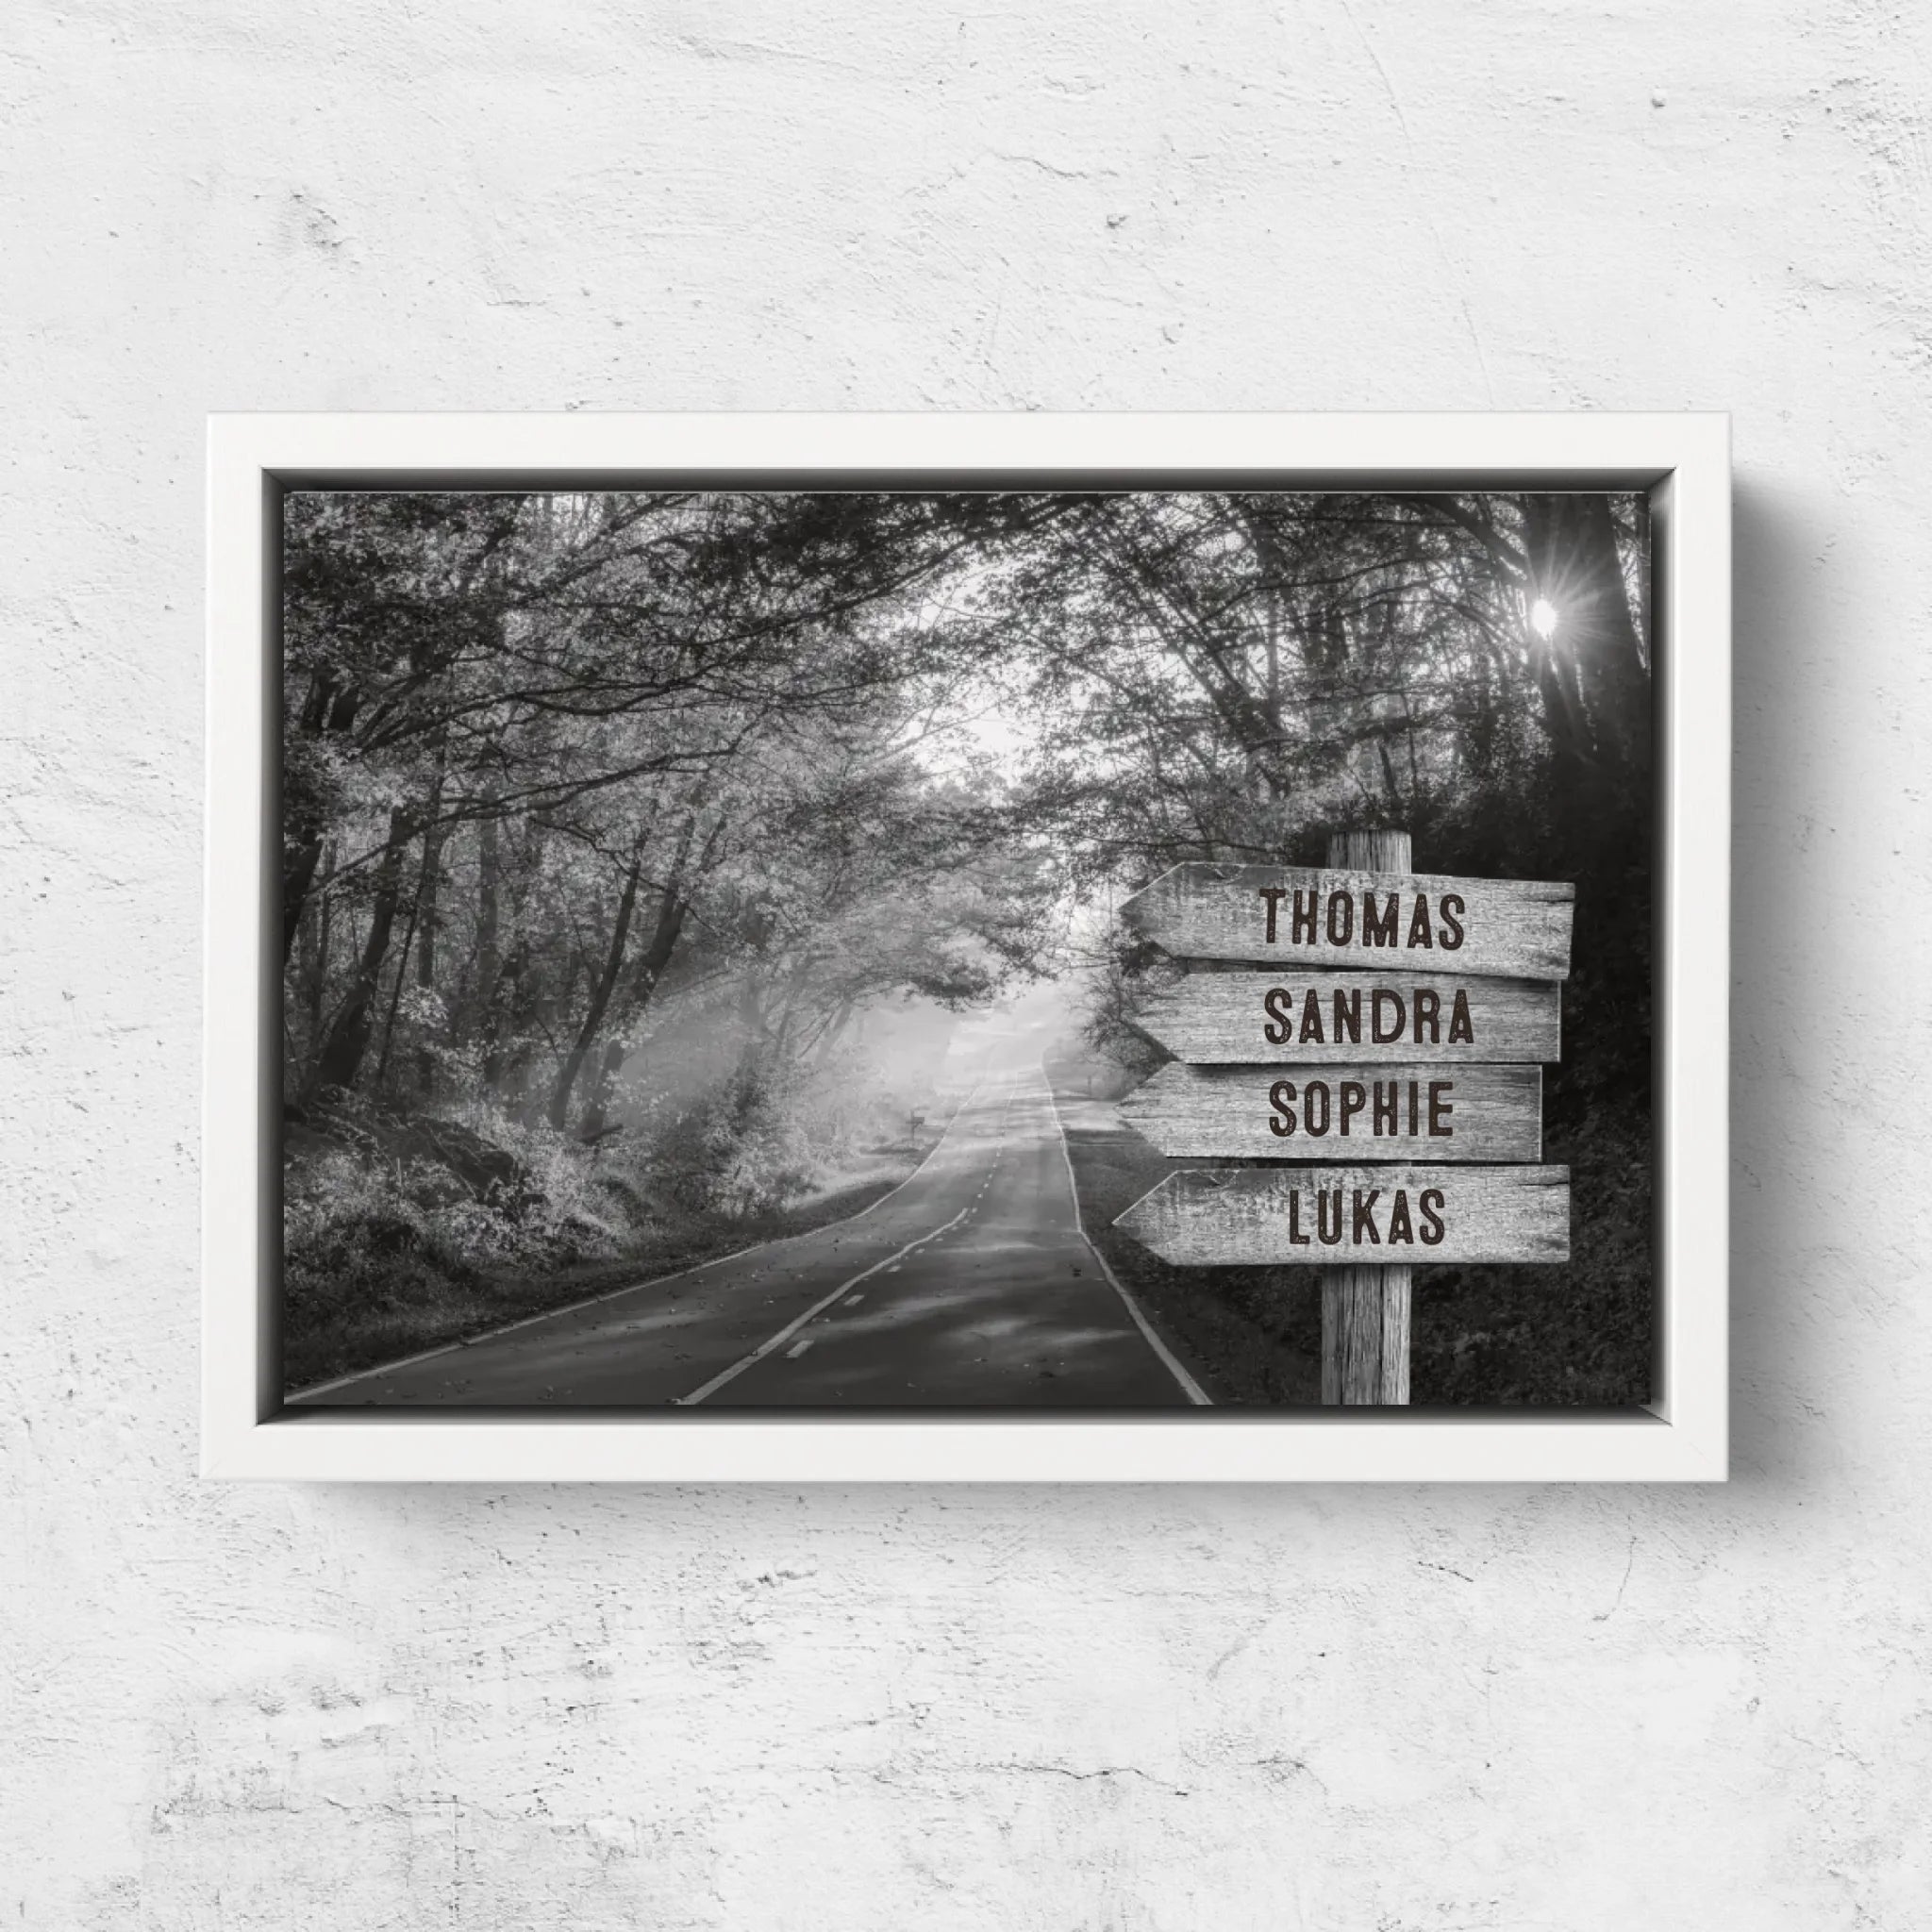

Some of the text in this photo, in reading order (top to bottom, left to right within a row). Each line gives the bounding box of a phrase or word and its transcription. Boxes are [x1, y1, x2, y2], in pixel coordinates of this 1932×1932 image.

[1258, 888, 1464, 950] THOMAS
[1265, 989, 1473, 1044] SANDRA
[1270, 1080, 1453, 1137] SOPHIE
[1290, 1190, 1444, 1245] LUKAS
